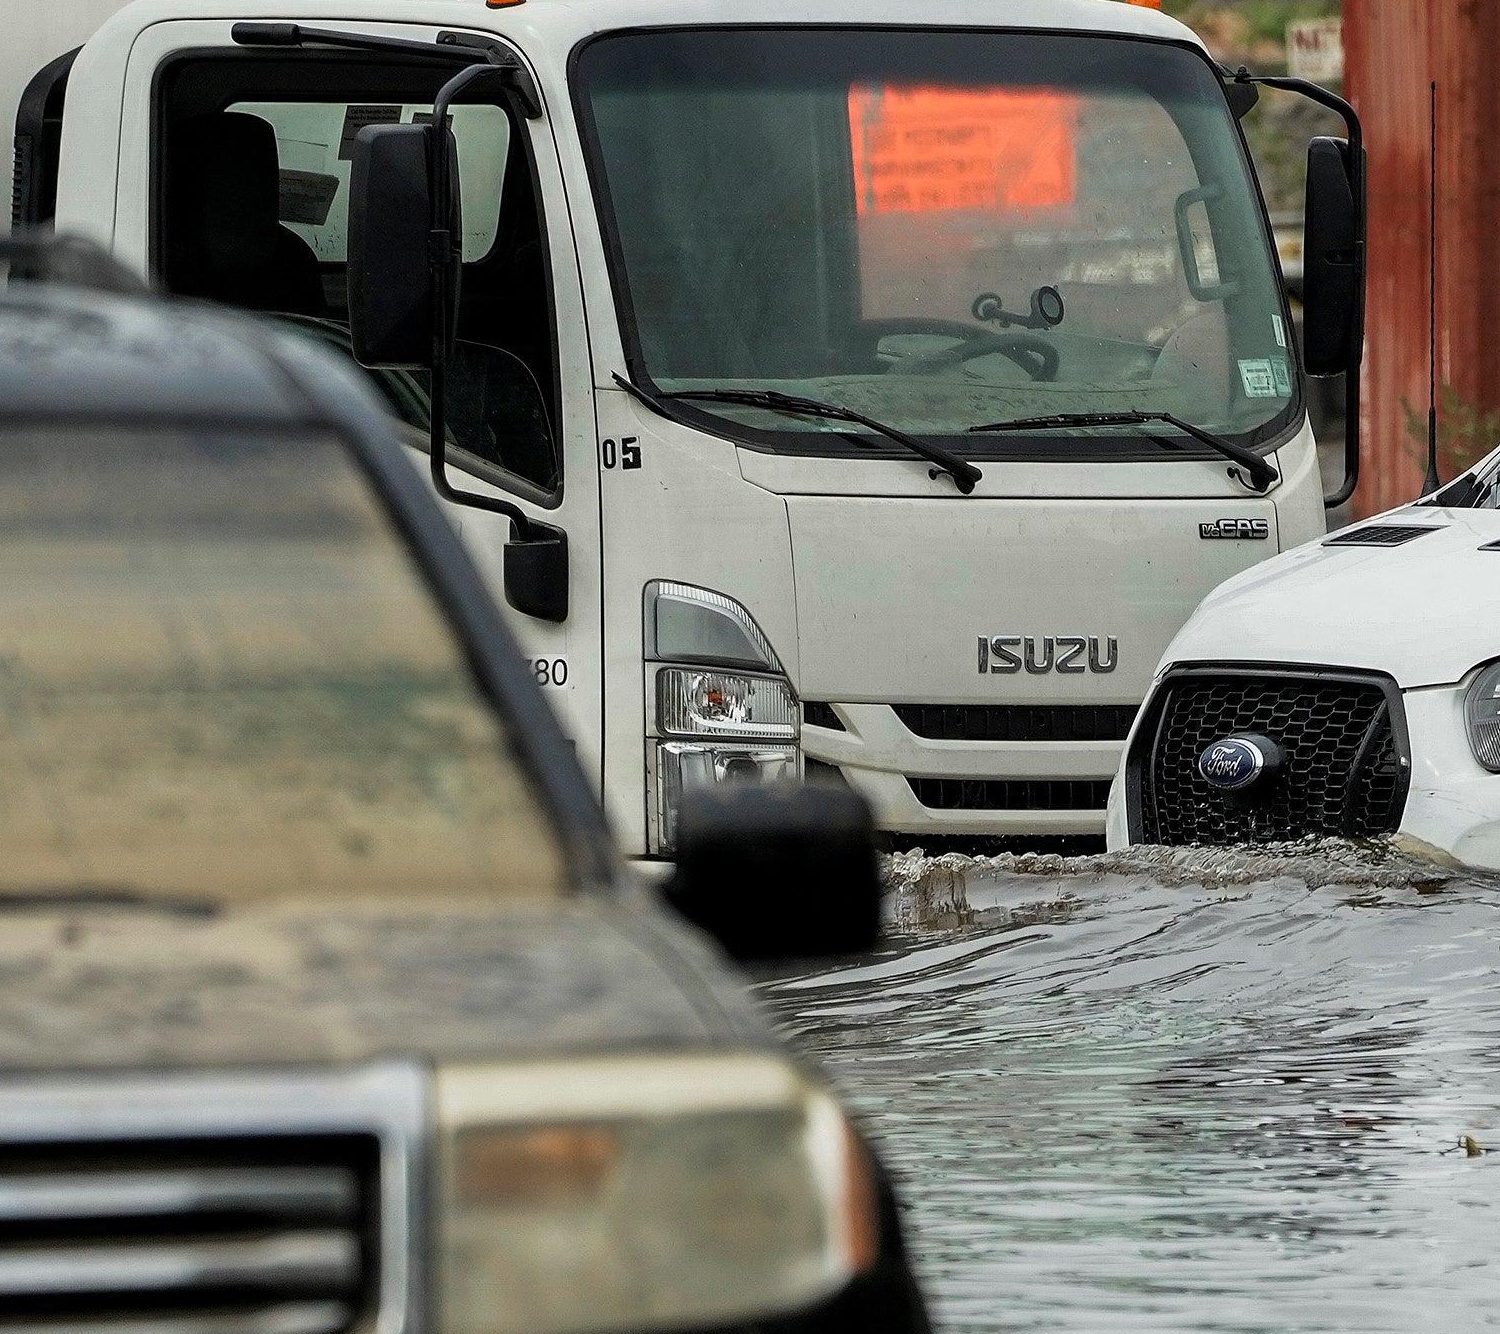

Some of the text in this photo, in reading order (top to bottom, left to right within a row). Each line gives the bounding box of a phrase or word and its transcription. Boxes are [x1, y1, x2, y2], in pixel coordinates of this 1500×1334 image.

[602, 436, 642, 470] 05
[977, 634, 1119, 675] ISUZU
[1207, 746, 1243, 777] Ford
